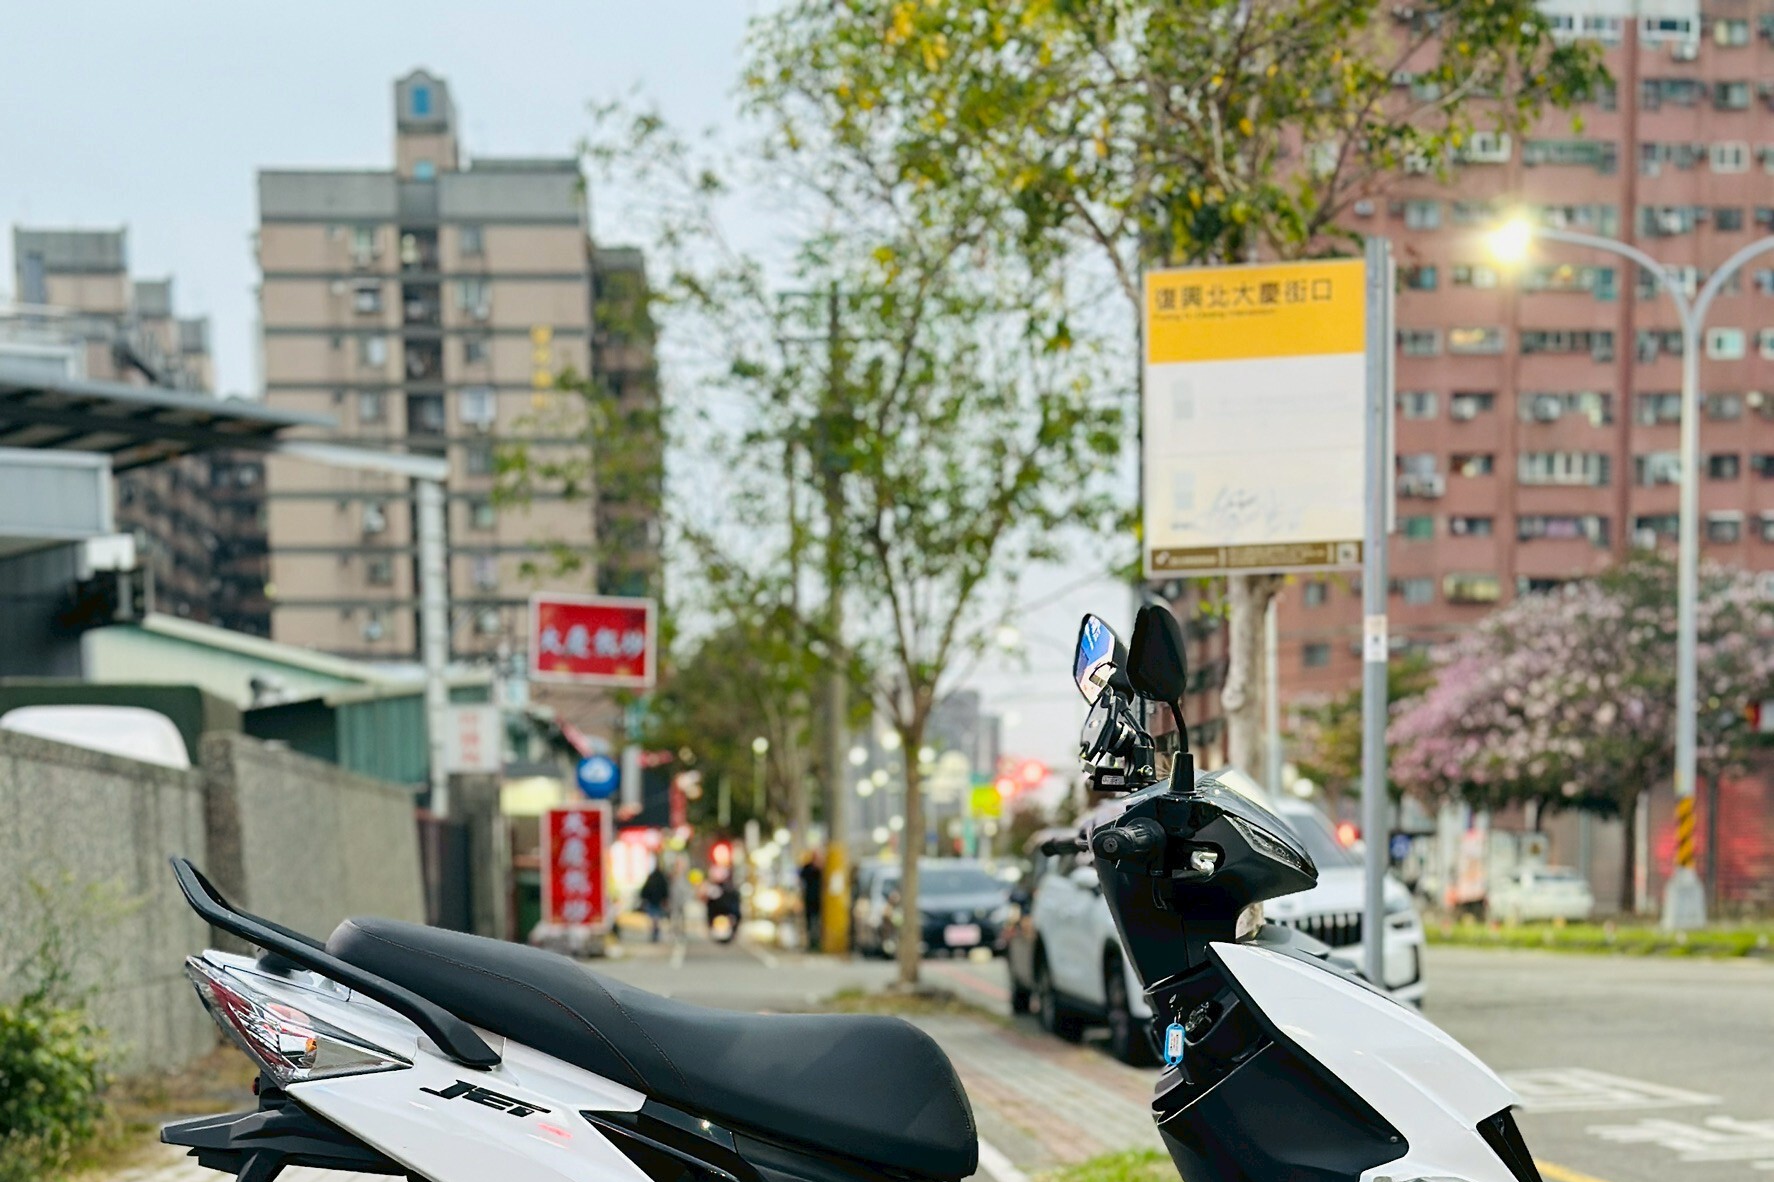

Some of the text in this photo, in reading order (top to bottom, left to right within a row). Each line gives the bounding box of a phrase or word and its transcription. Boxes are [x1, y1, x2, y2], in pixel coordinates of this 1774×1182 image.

[1155, 278, 1333, 310] 復興北大慶街口
[419, 1079, 552, 1117] JET
